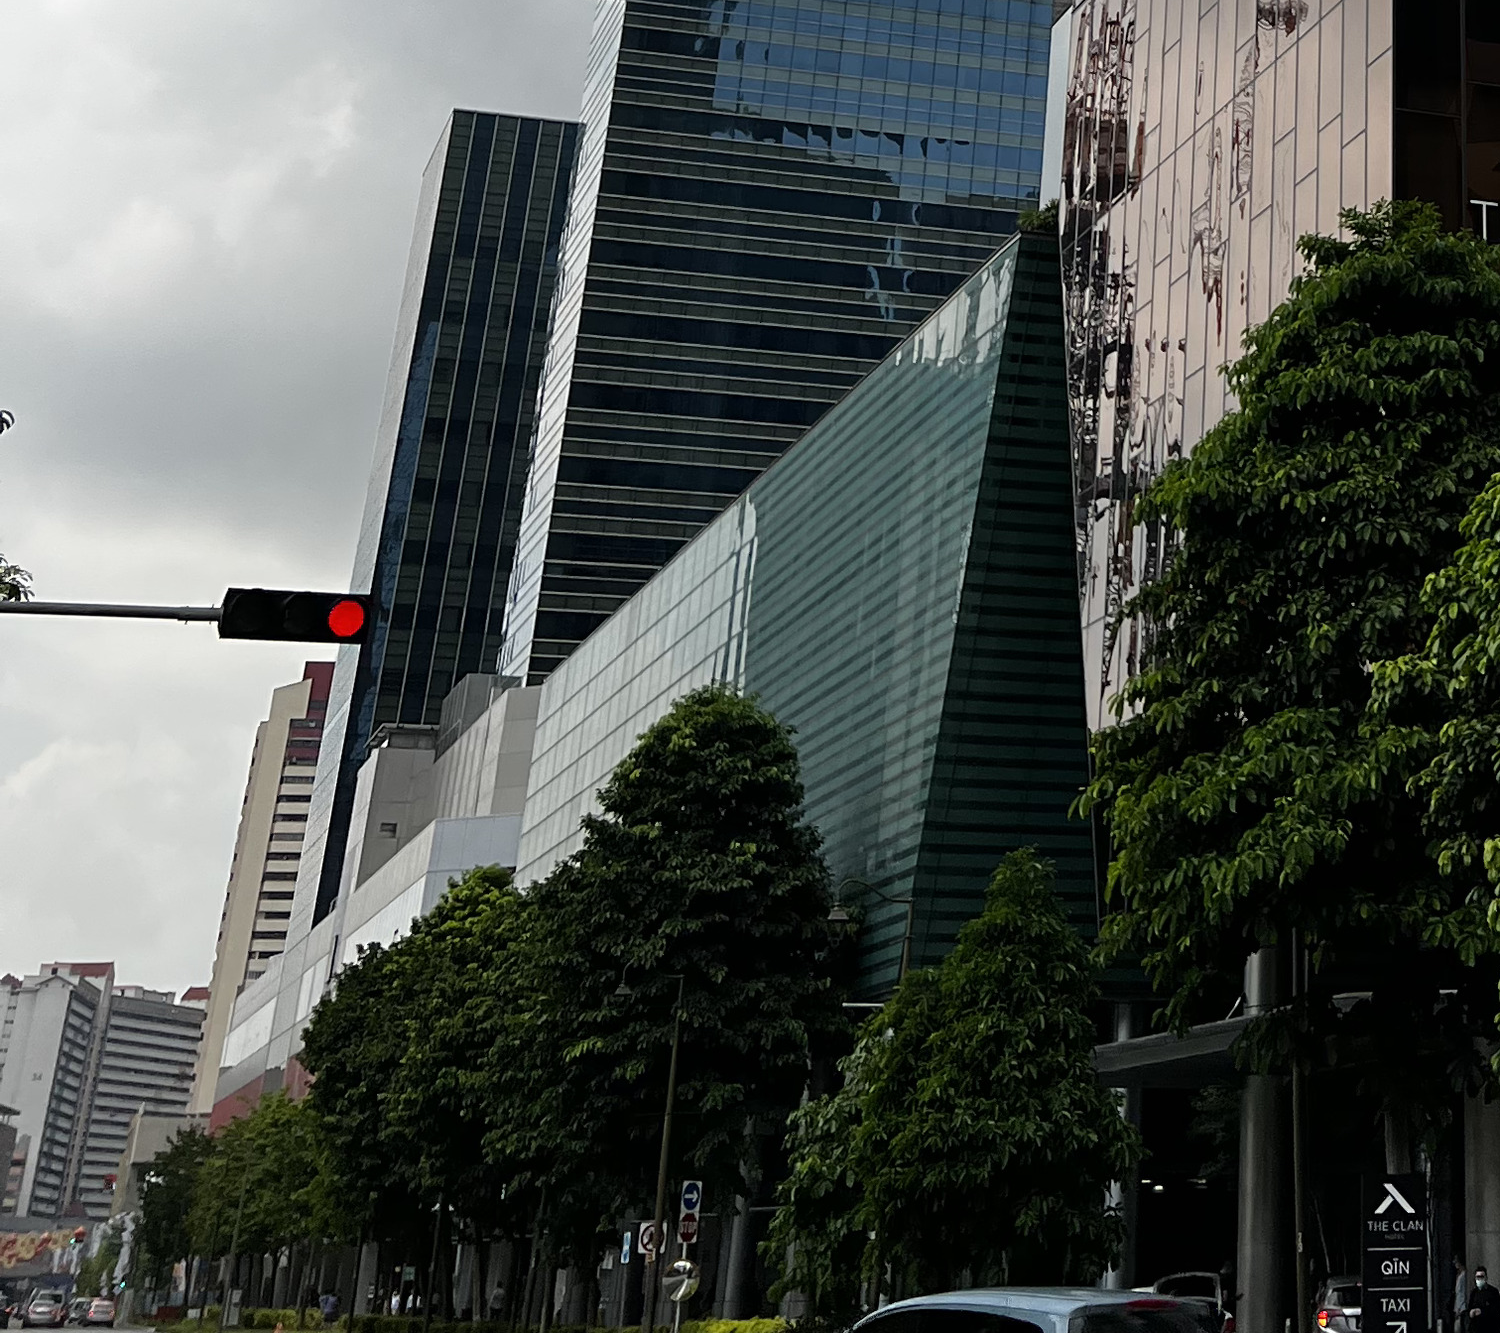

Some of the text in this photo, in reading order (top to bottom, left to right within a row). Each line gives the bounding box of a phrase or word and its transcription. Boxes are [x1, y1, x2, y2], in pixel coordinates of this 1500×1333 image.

[1367, 1220, 1424, 1232] THE CLAN
[1380, 1298, 1410, 1313] TAXI
